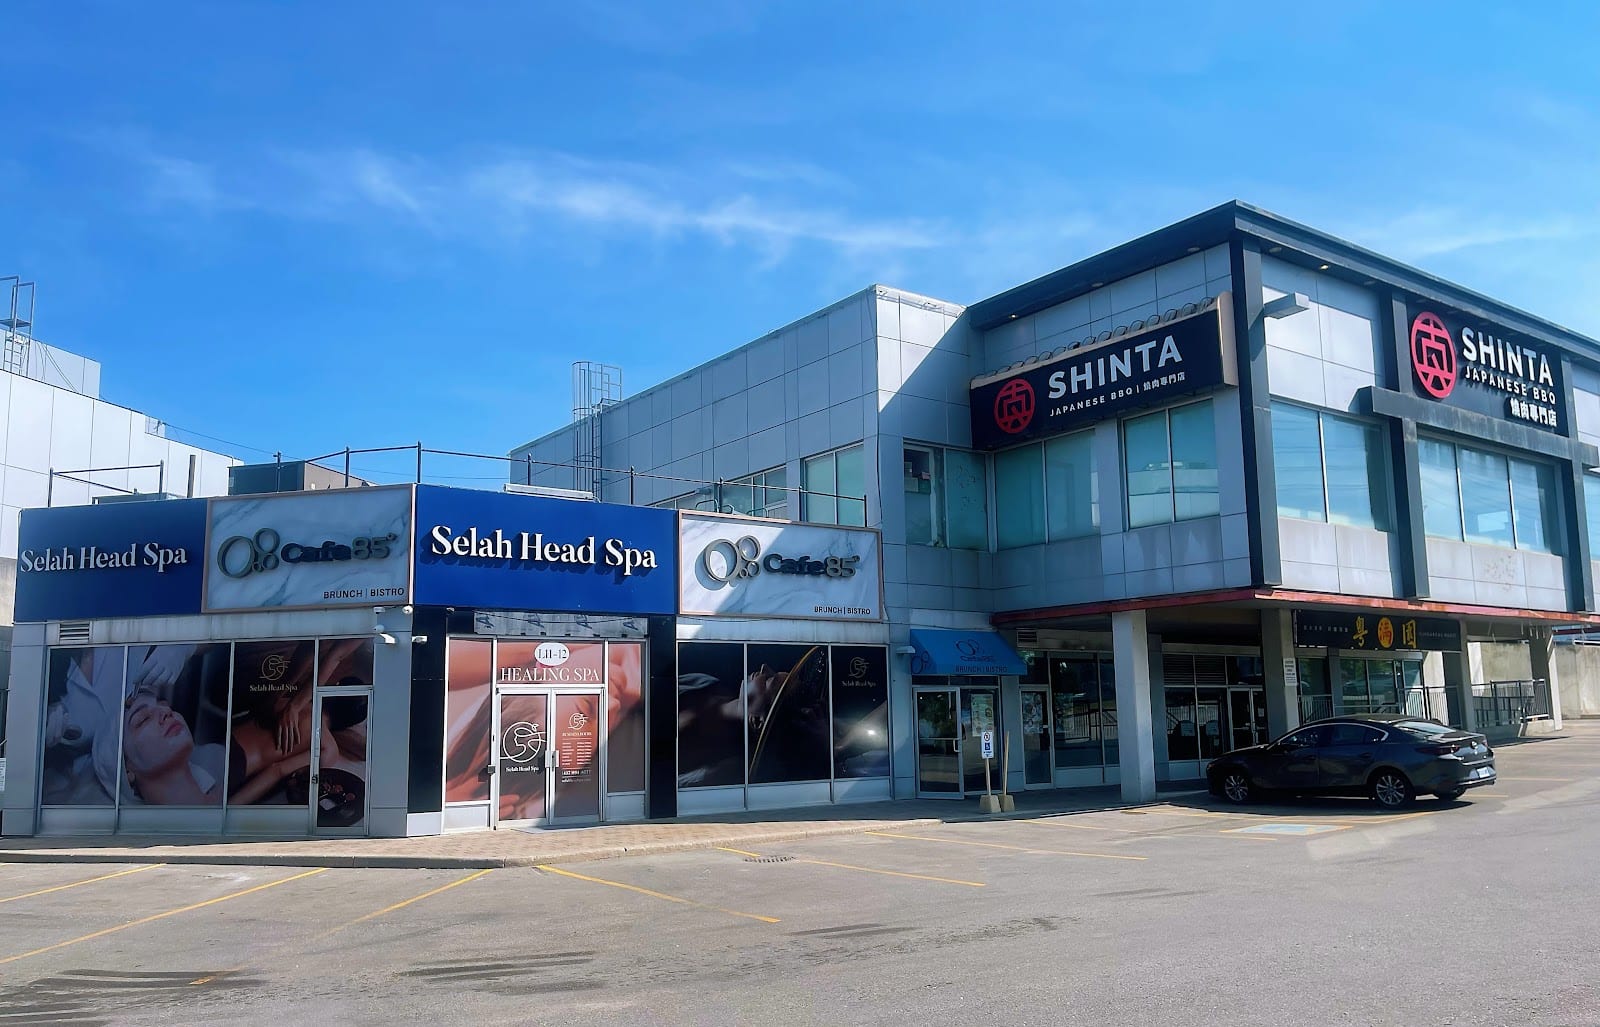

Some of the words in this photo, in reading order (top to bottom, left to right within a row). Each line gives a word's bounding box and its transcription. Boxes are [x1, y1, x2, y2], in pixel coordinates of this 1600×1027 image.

[1048, 335, 1183, 399] SHINTA
[1462, 326, 1554, 387] SHINTA
[1465, 365, 1528, 396] JAPANESE
[1533, 387, 1556, 405] BBQ
[1050, 395, 1106, 417] JAPANESE
[1110, 387, 1133, 400] BBQ
[20, 547, 75, 573] Selah
[79, 543, 137, 569] Head
[143, 542, 188, 573] Spa
[431, 525, 513, 559] Selah
[520, 532, 597, 564] Head
[605, 538, 658, 576] Spa
[323, 589, 363, 600] BRUNCH
[370, 587, 405, 597] BISTRO
[814, 606, 843, 614] BRUNCH
[847, 607, 871, 615] BISTRO
[249, 684, 267, 692] Selah
[285, 684, 298, 693] Spa
[501, 667, 570, 682] HEALING
[573, 667, 600, 682] SPA
